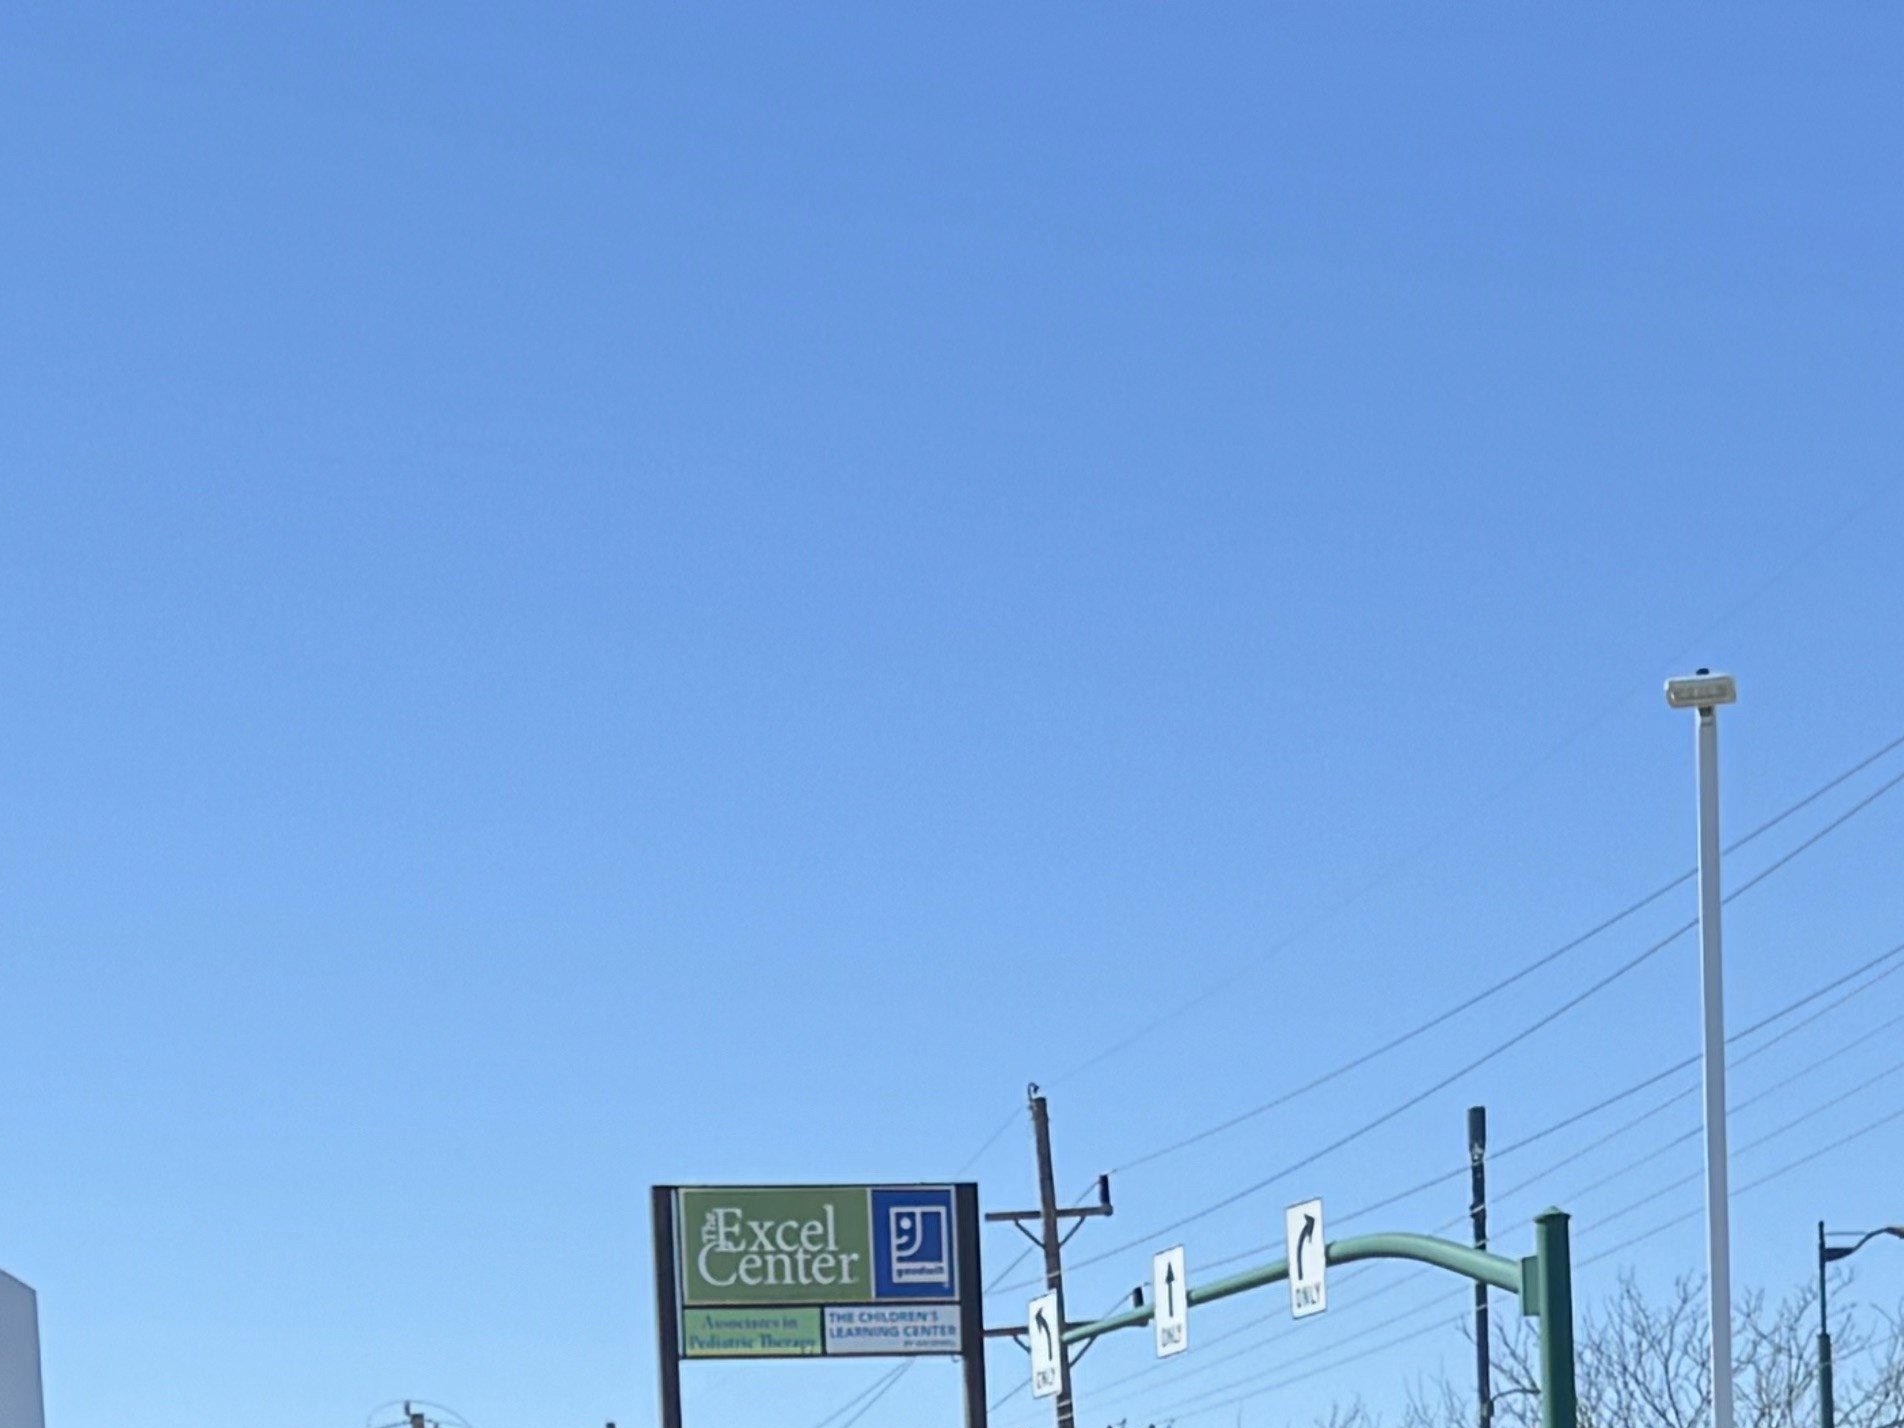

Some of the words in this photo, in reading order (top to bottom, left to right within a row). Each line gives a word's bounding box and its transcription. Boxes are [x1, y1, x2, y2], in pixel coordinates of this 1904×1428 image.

[712, 1203, 839, 1252] Excel
[697, 1240, 860, 1287] Center
[1296, 1281, 1321, 1309] ONLY
